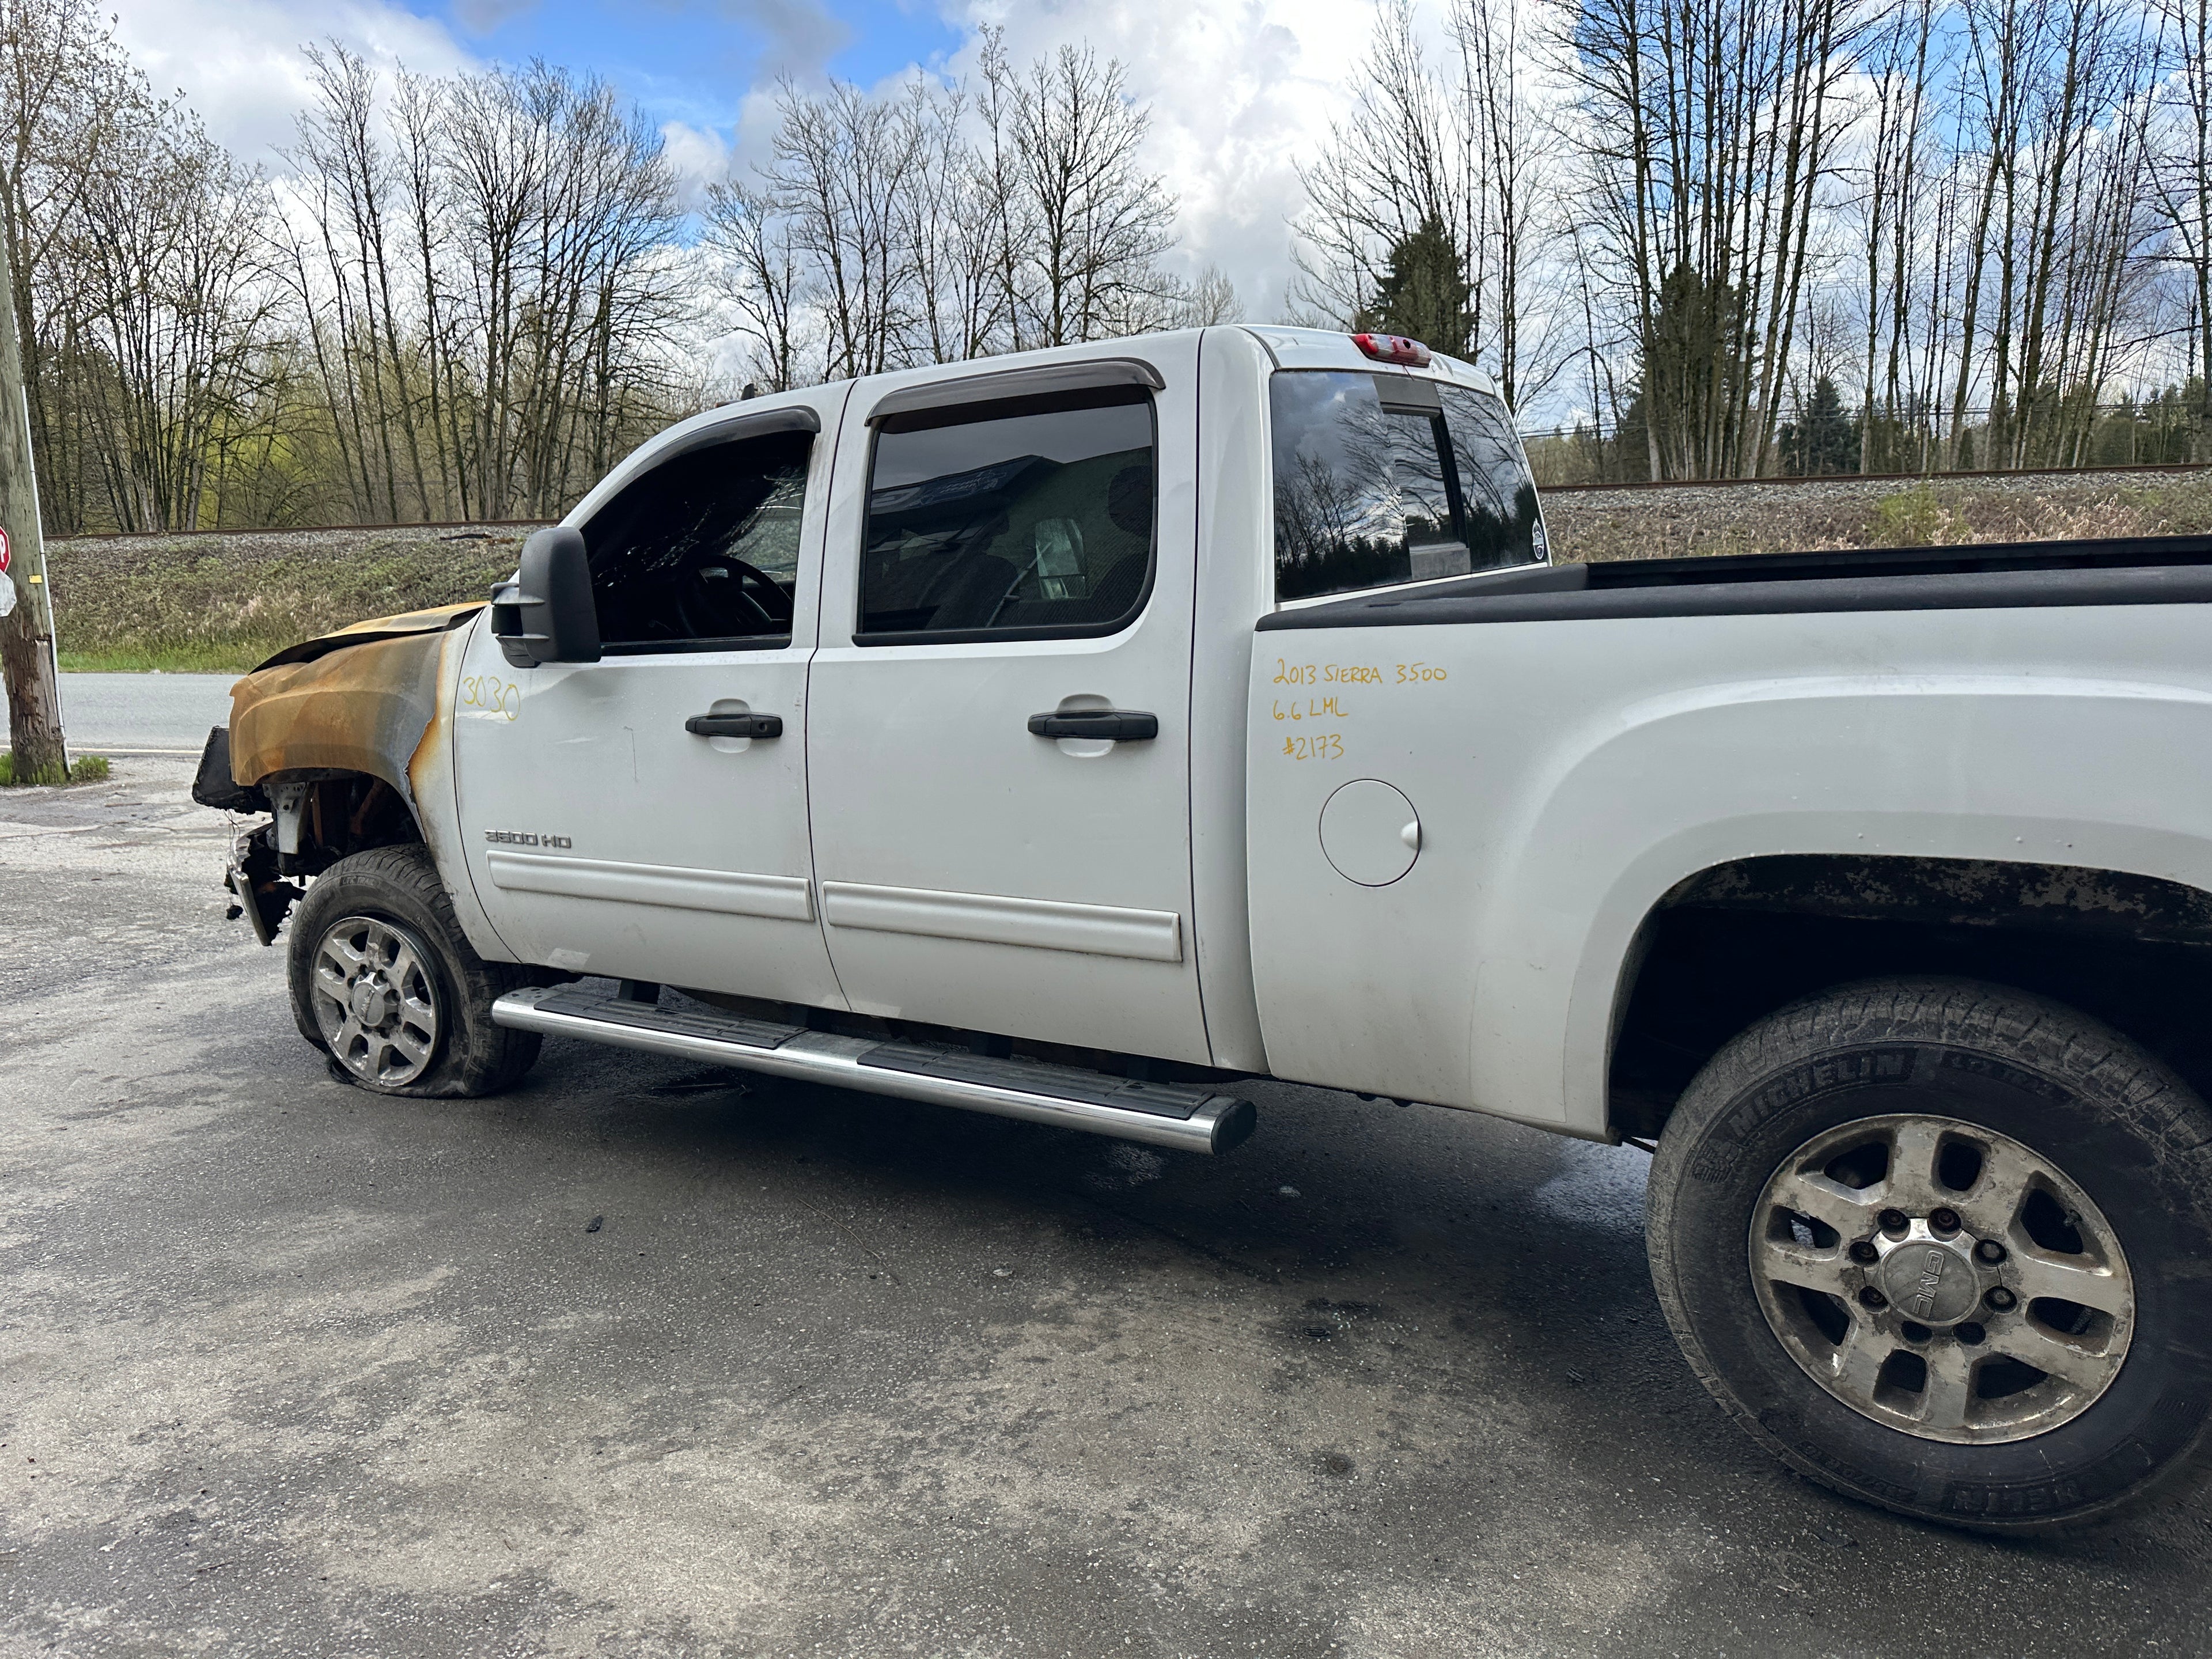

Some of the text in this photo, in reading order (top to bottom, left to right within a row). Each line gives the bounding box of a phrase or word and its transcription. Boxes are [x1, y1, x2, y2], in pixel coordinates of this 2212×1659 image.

[1273, 658, 1448, 685] 2013 SIERRA 3500
[462, 675, 521, 721] 3030
[1309, 696, 1349, 717] LML
[1282, 733, 1344, 760] #2173
[484, 829, 572, 849] 3500 HD
[1728, 1052, 1906, 1138] MICHELIN
[1912, 1250, 1945, 1318] GMC
